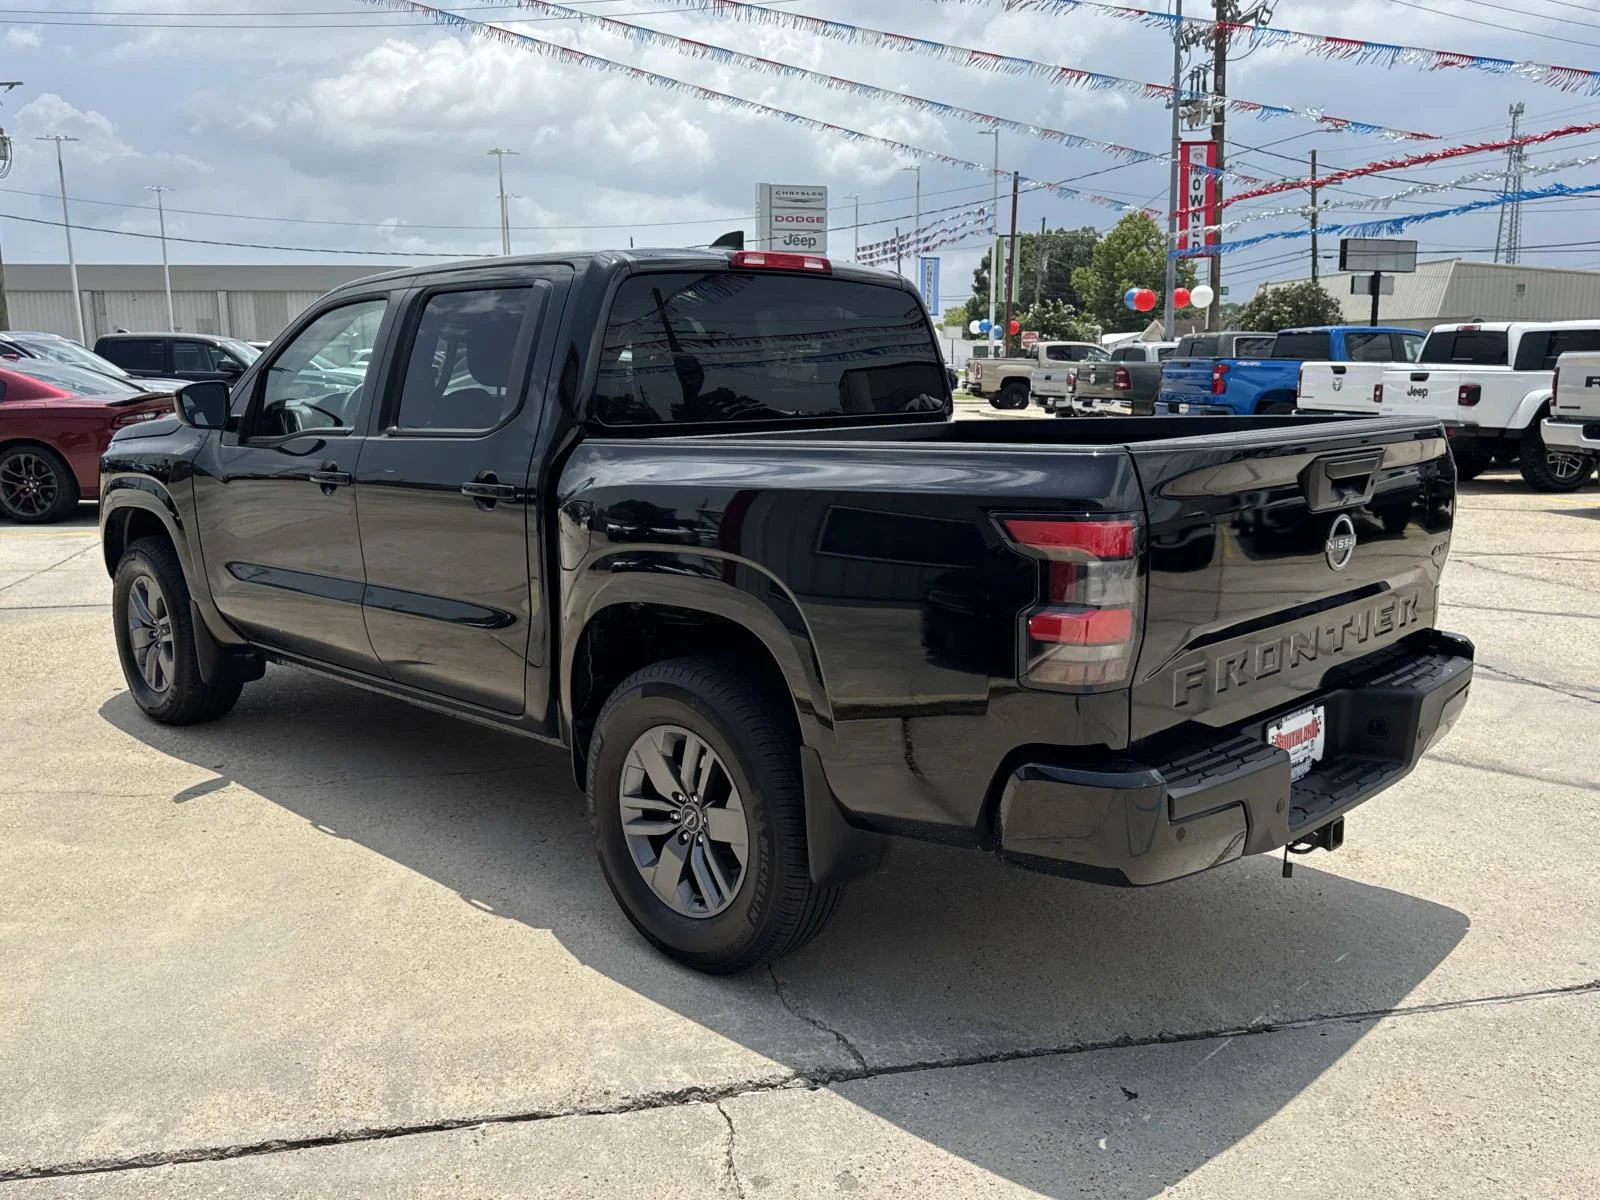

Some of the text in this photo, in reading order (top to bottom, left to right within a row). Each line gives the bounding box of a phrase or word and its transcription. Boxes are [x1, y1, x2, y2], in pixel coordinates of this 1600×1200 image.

[775, 215, 825, 224] DODGE
[1190, 178, 1204, 251] OWNED
[783, 233, 817, 249] Jeep
[1407, 385, 1429, 398] Jeep
[1172, 588, 1421, 708] FRONTIER
[1275, 718, 1319, 751] SOUTHLAND
